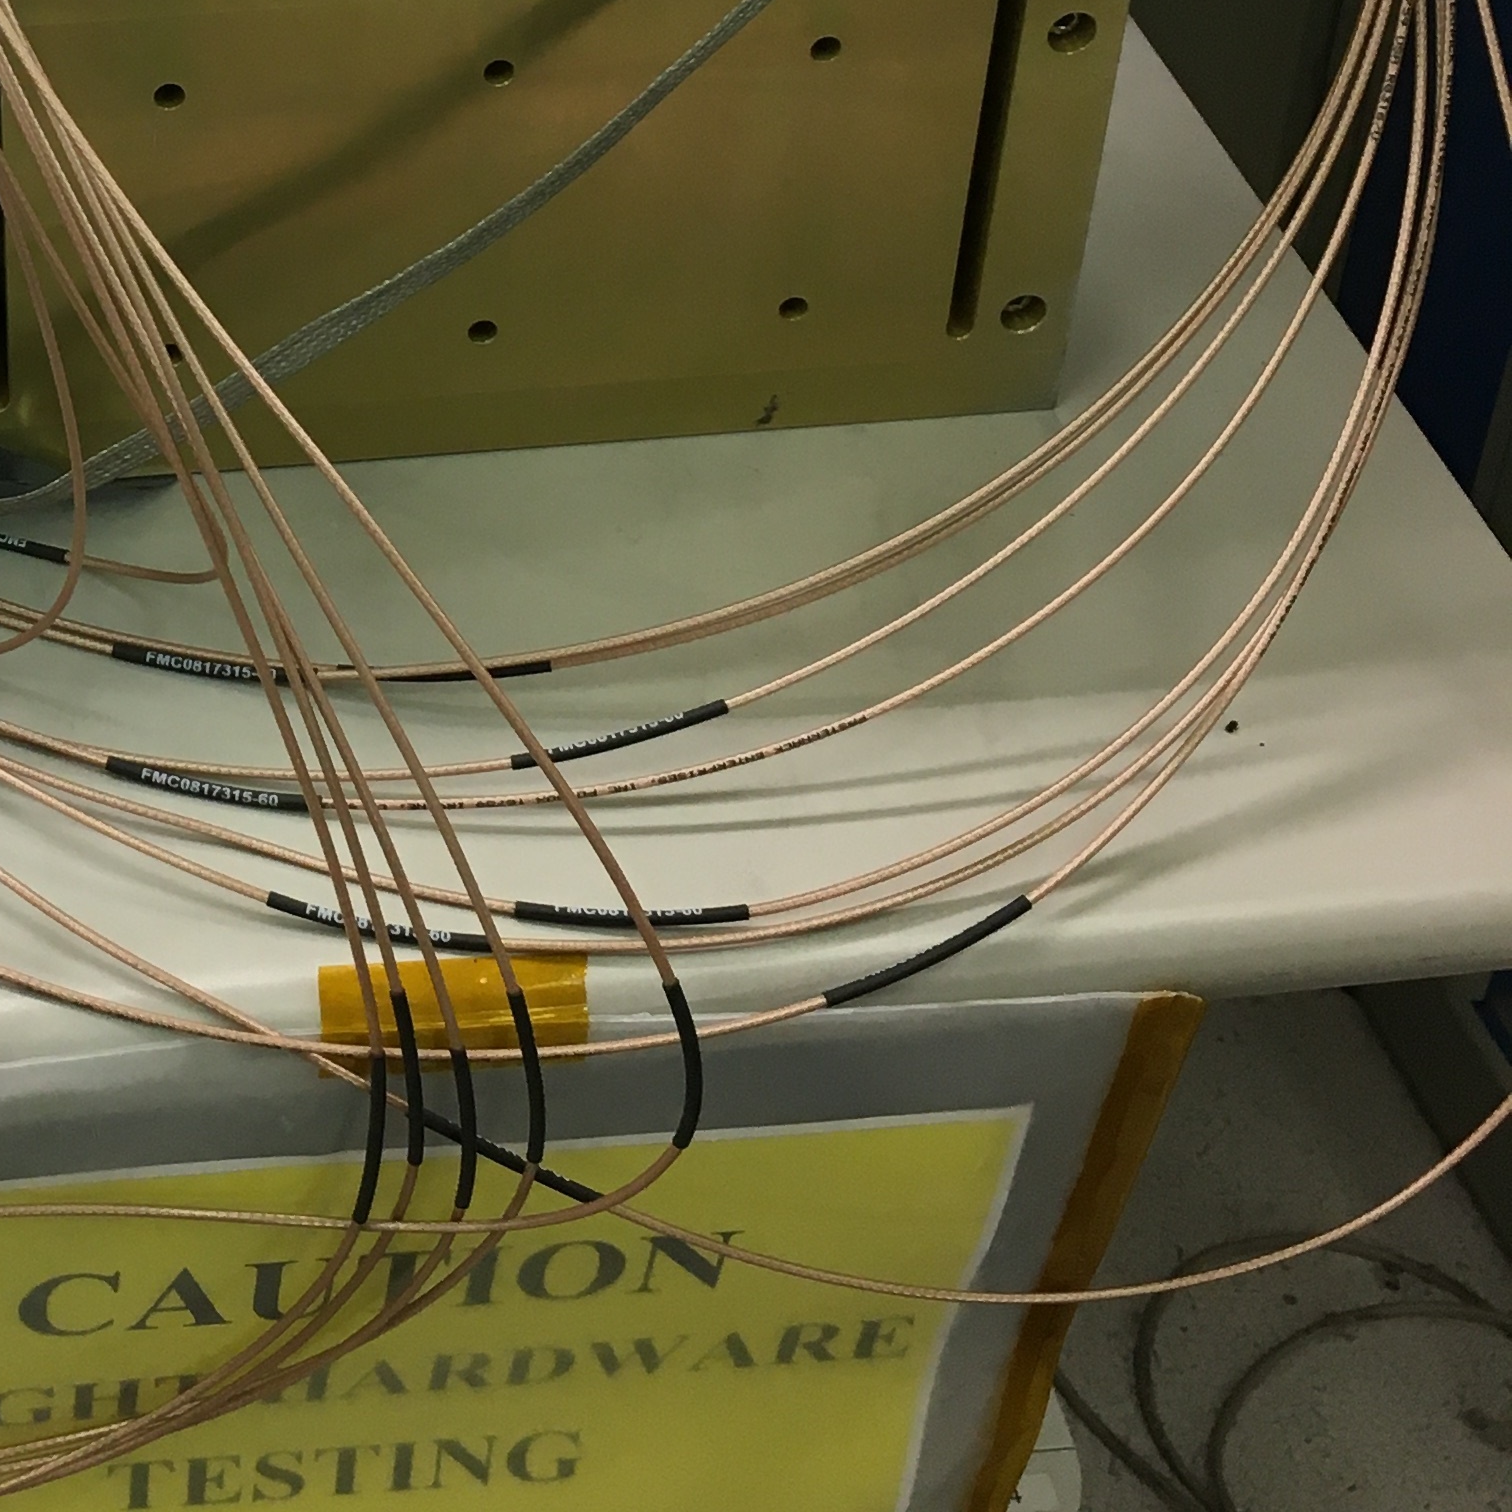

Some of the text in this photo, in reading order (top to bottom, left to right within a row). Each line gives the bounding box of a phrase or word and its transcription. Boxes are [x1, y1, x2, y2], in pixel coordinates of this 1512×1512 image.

[145, 650, 277, 680] FMC0817315-
[140, 766, 279, 808] FMC0817315-60
[18, 1230, 745, 1336] CAUTION
[106, 1428, 583, 1510] TESTING
